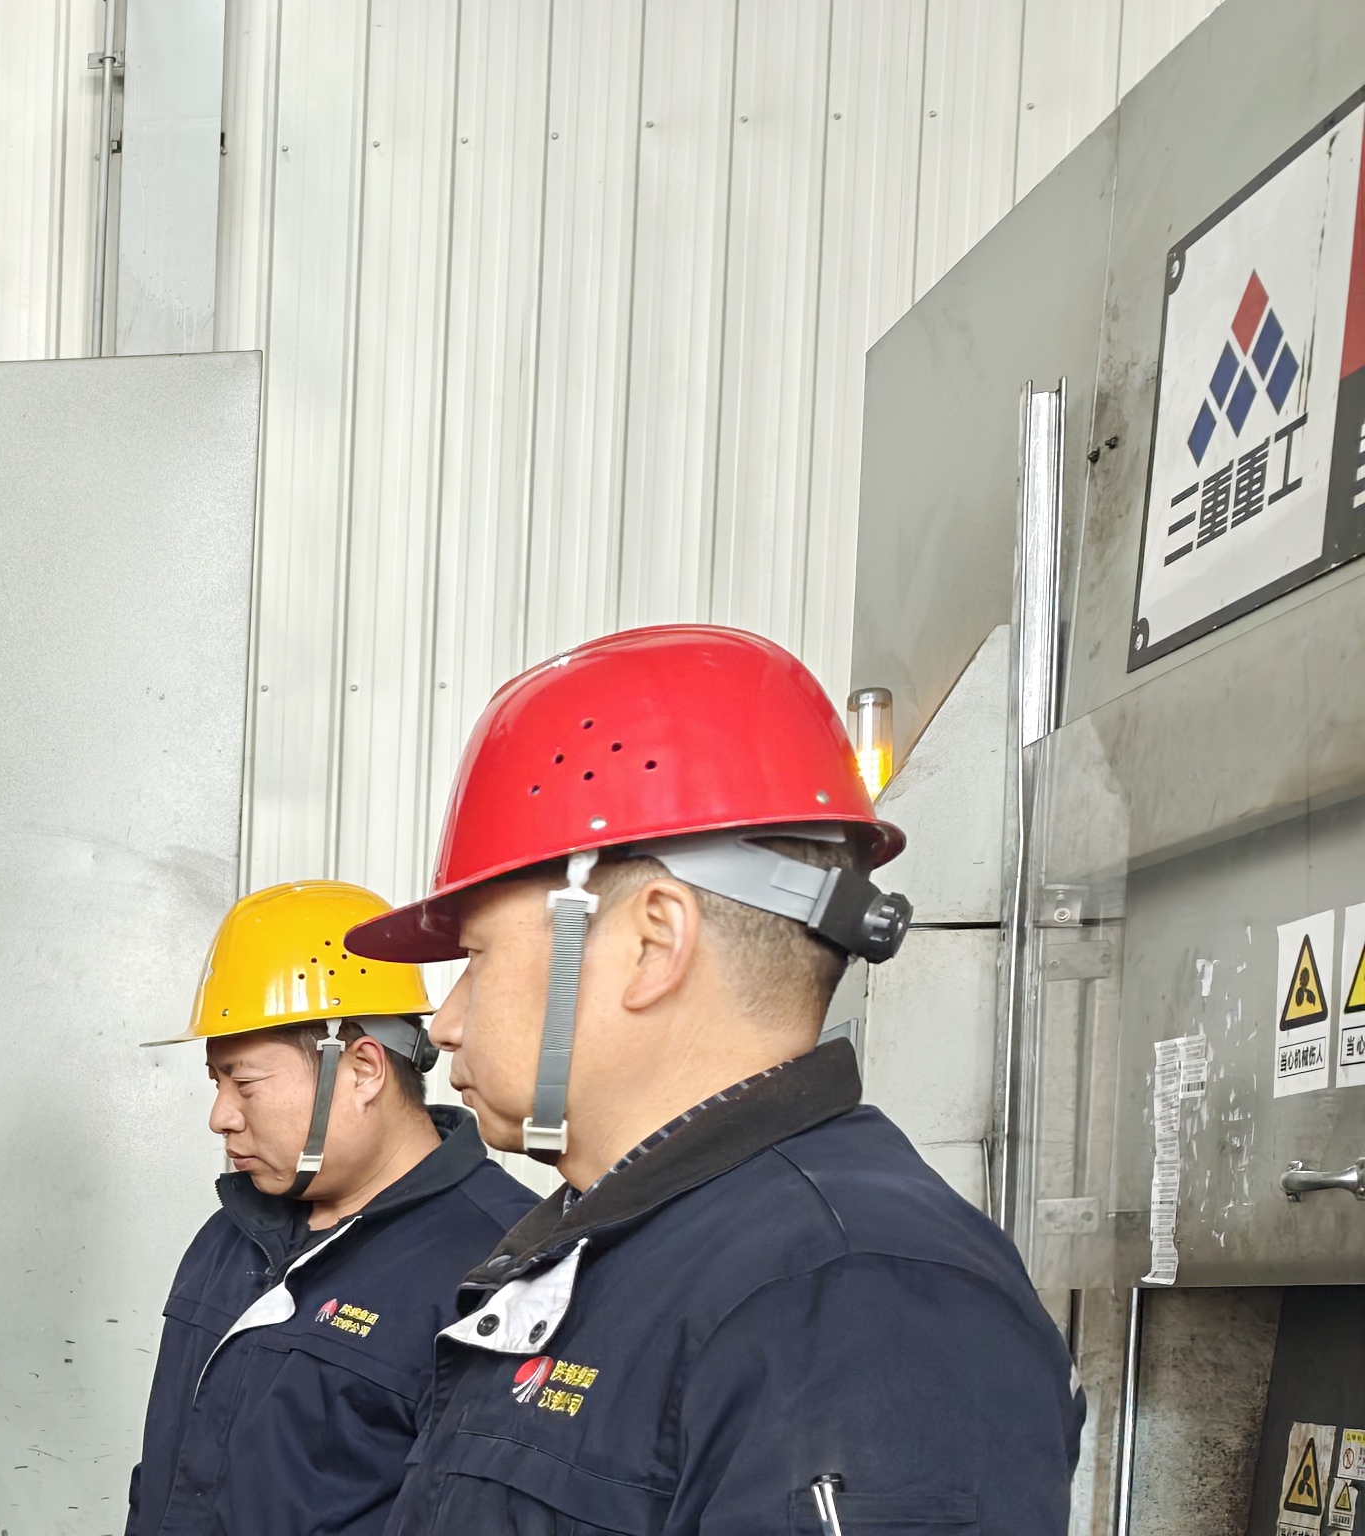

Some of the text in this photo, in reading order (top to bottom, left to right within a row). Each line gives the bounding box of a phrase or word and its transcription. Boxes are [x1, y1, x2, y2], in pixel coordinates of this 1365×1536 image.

[1163, 412, 1309, 567] 三重重工
[1279, 1043, 1324, 1073] 当心机械伤人
